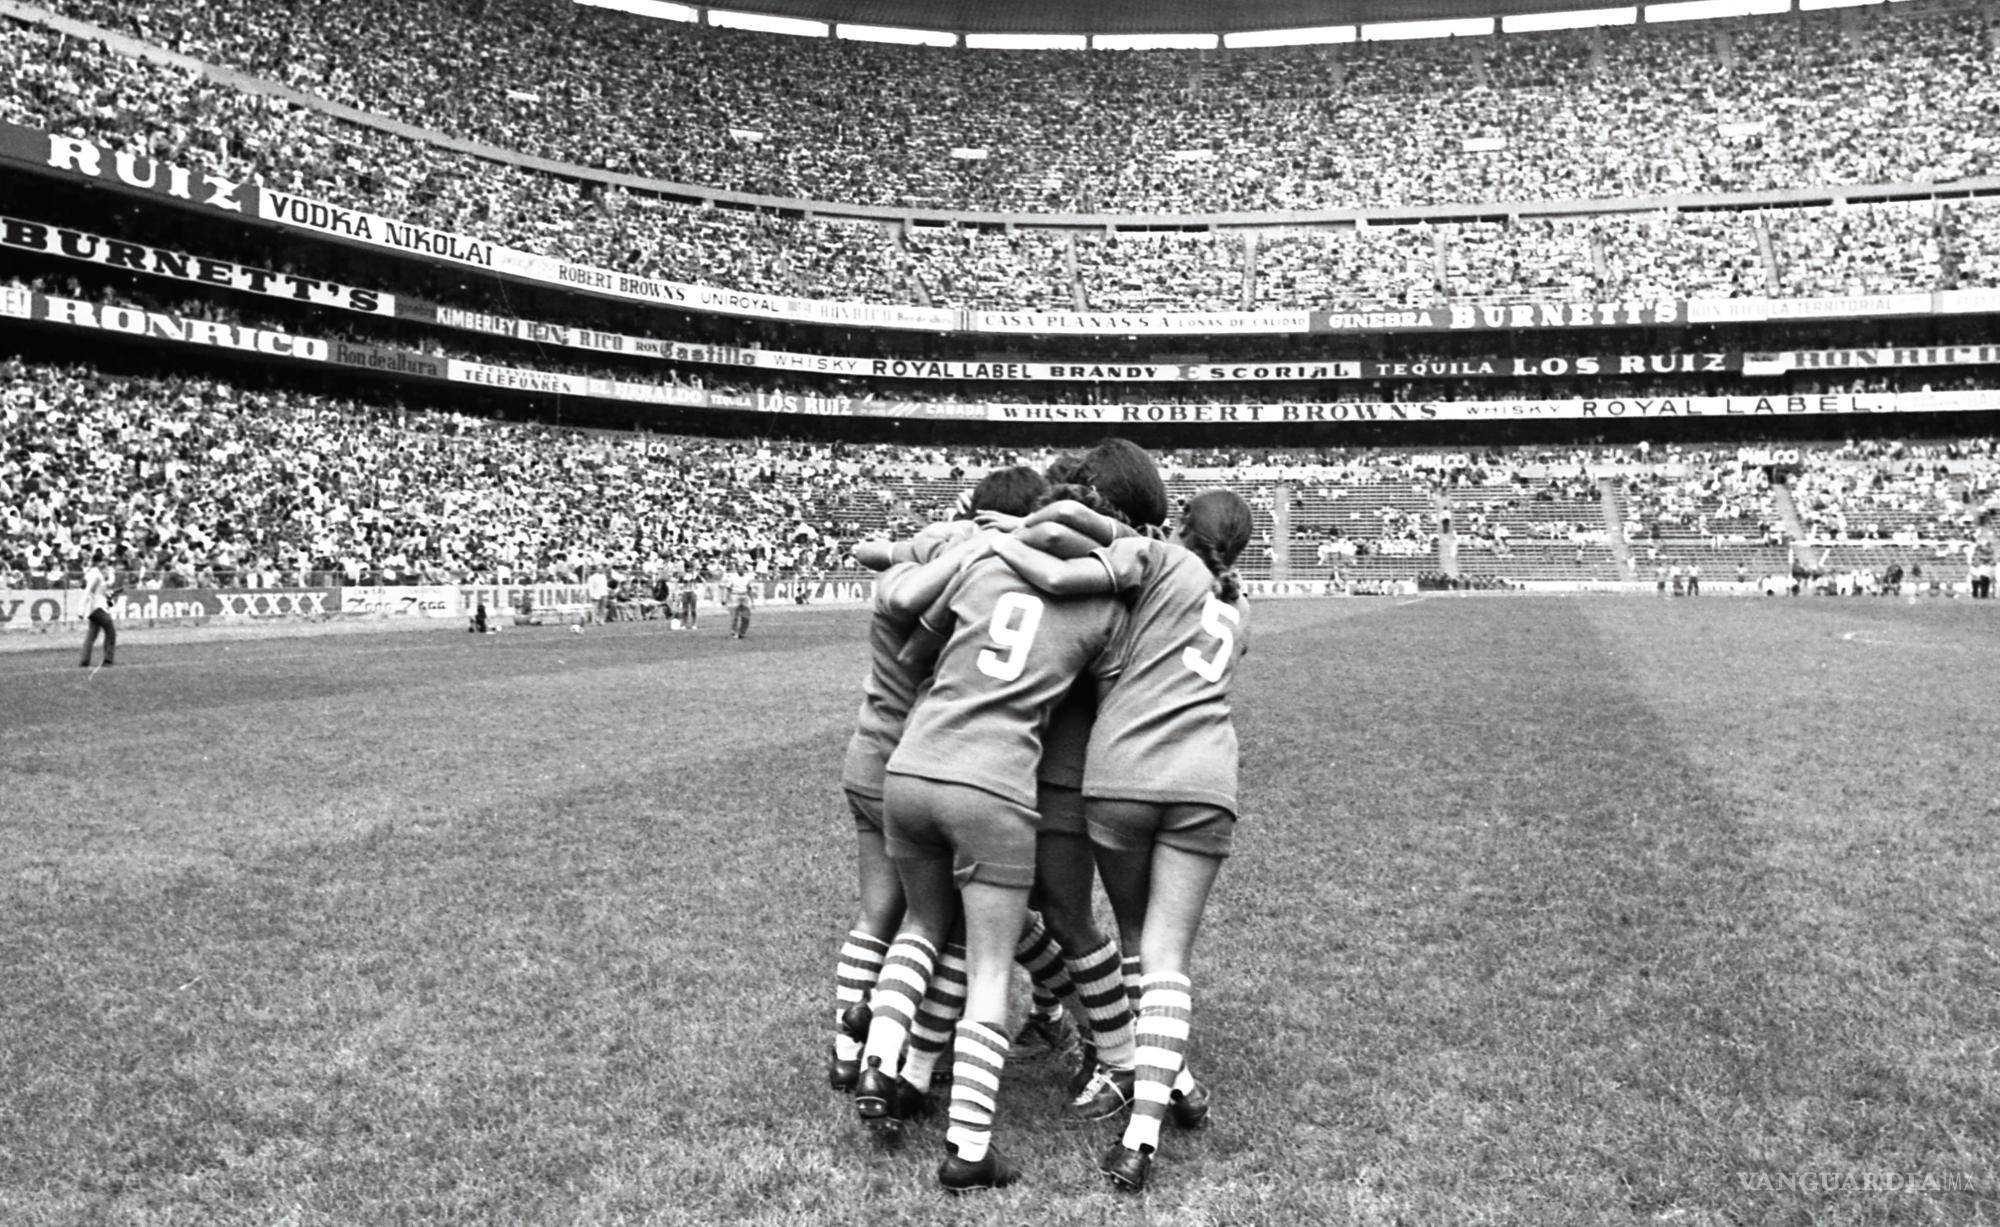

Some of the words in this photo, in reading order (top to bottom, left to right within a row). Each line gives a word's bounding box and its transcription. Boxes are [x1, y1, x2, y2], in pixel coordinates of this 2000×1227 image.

[47, 133, 242, 212] RUIZ
[269, 193, 373, 240] VODKA
[385, 222, 493, 266] NIKOLAI
[1, 218, 379, 312] BURNETT'S
[558, 264, 613, 290] ROBERT
[701, 293, 779, 313] UNIROYAL
[1449, 299, 1678, 329] BURNETT'S
[44, 295, 329, 362] RONRICO
[437, 306, 516, 337] KIMBERLEY
[985, 315, 1034, 327] CASA
[1329, 311, 1433, 328] GINEBRA
[580, 330, 623, 351] RICO
[660, 340, 756, 366] Castillo
[337, 344, 366, 366] Ron
[774, 354, 858, 372] WHISKY
[872, 360, 955, 378] ROYAL
[962, 363, 1032, 379] LABEL
[1376, 361, 1495, 376] TEQUILA
[1512, 356, 1600, 376] LOS
[1619, 353, 1727, 373] RUIZ
[464, 369, 571, 393] TELEFUNKEN
[1050, 365, 1158, 379] BRANDY
[757, 393, 798, 413] LOS
[804, 396, 853, 416] RUIZ
[1003, 407, 1106, 420] WHISKY
[1122, 405, 1264, 422] ROBERT
[1282, 403, 1438, 420] BROWN'S
[1465, 404, 1560, 415] WHISKY
[1582, 399, 1703, 416] ROYAL
[215, 591, 328, 617] XXXXX
[976, 591, 1044, 682] 9
[1182, 591, 1240, 683] 5
